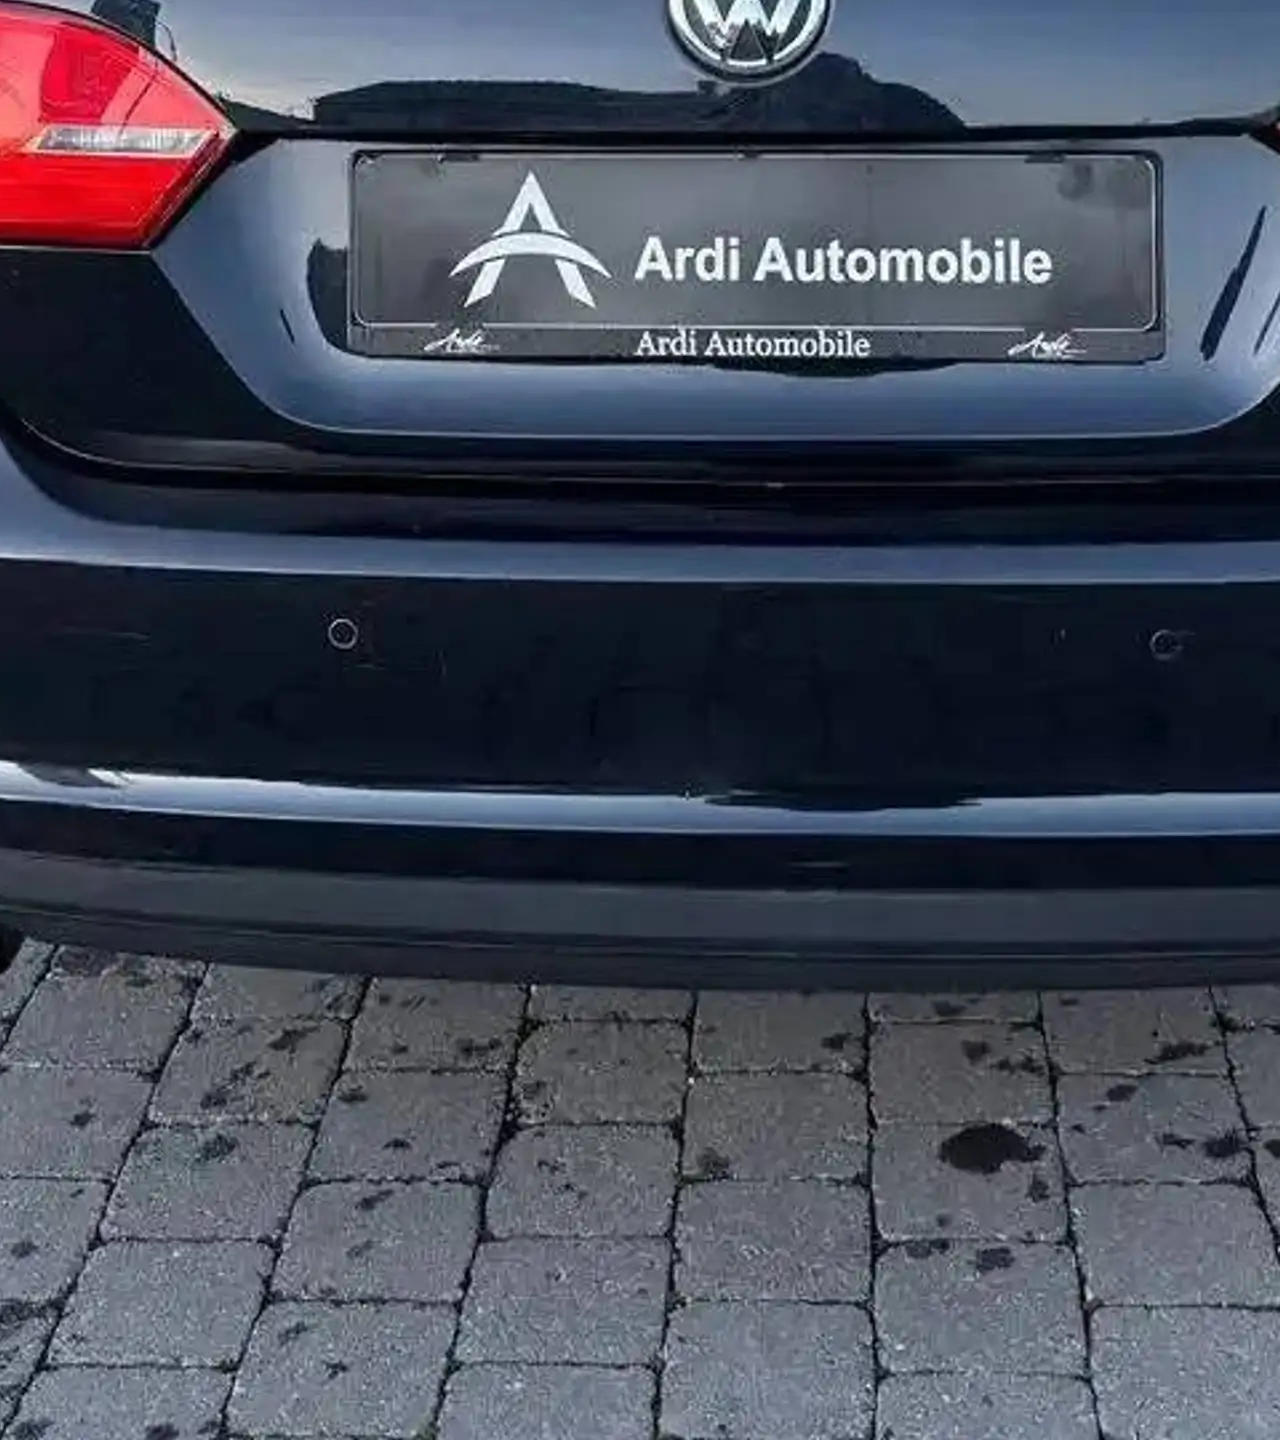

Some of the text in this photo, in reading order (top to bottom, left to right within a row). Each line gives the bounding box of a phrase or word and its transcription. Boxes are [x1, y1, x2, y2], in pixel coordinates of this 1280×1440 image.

[634, 235, 1053, 283] Ardi Automobile
[634, 326, 871, 357] Ardi Automobile
